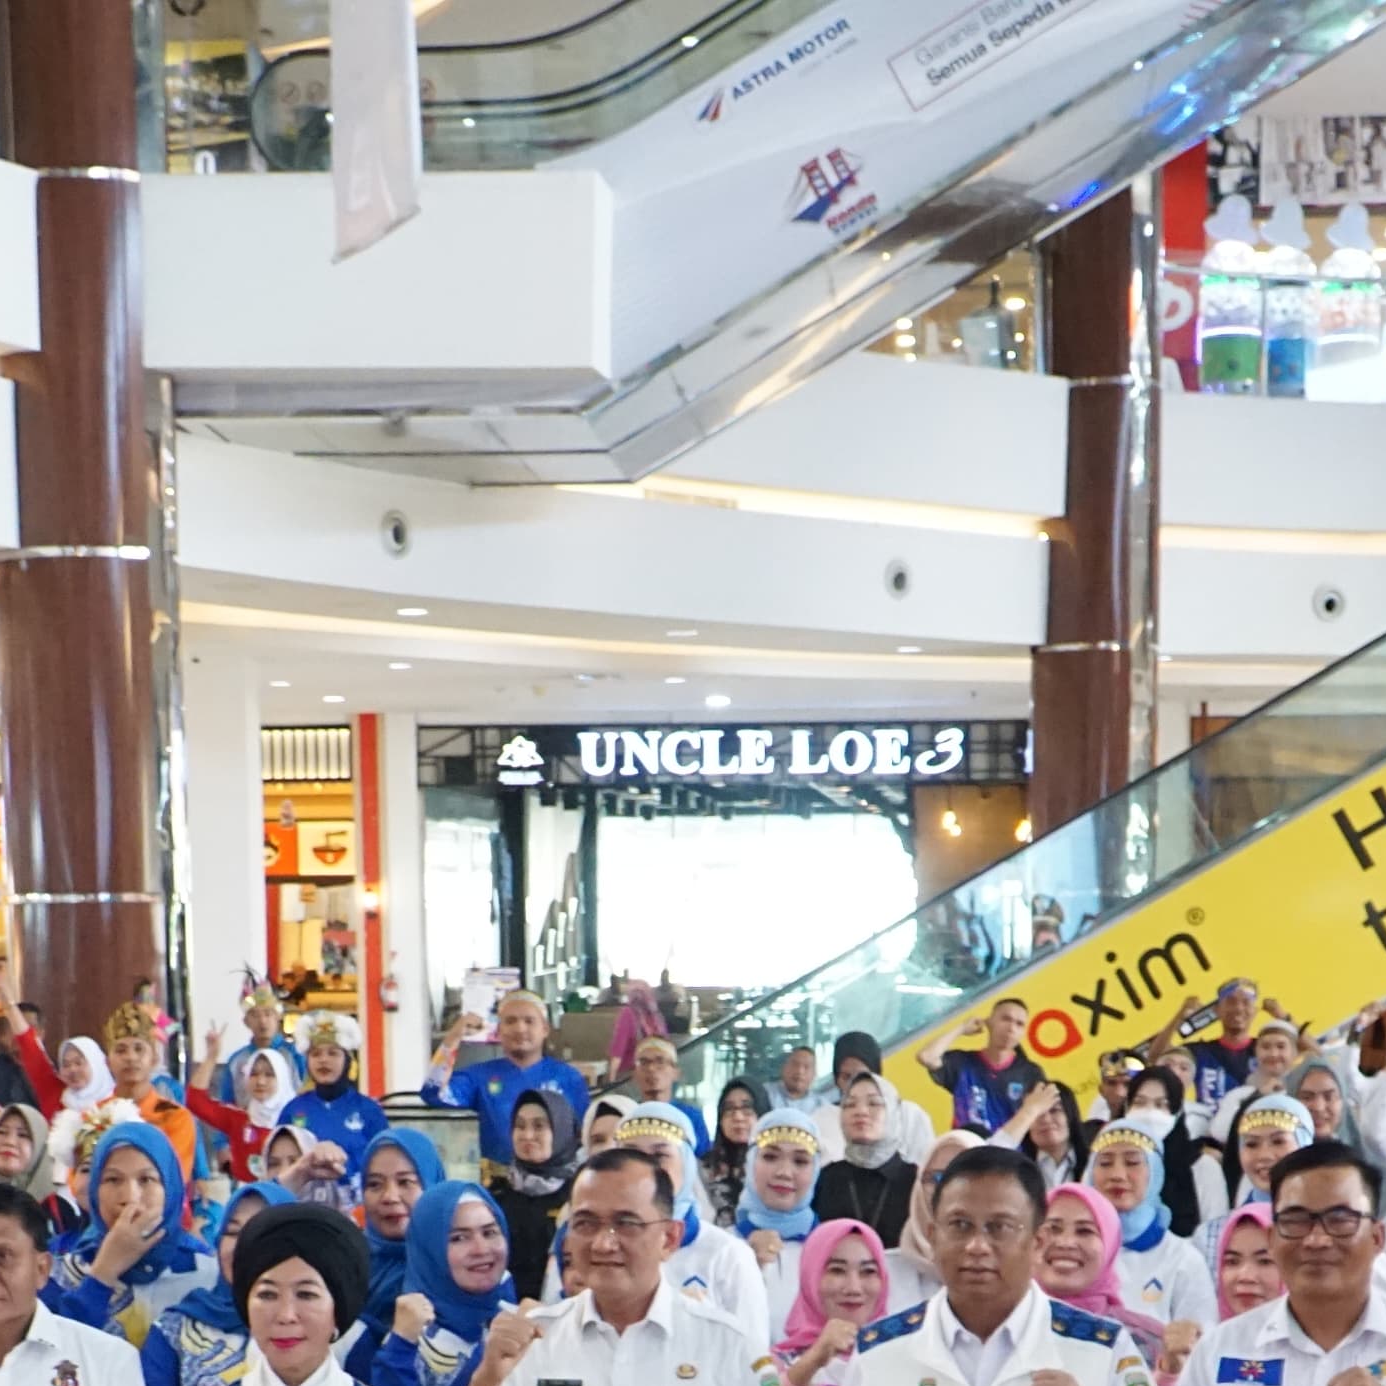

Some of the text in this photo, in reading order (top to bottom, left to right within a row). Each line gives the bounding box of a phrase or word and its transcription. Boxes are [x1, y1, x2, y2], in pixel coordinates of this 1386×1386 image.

[732, 60, 787, 99] ASTRA
[787, 18, 851, 64] MOTOR
[926, 43, 987, 87] Semua
[988, 1, 1056, 47] Sepeda
[577, 729, 775, 777] UNCLE
[1027, 932, 1212, 1058] axim
